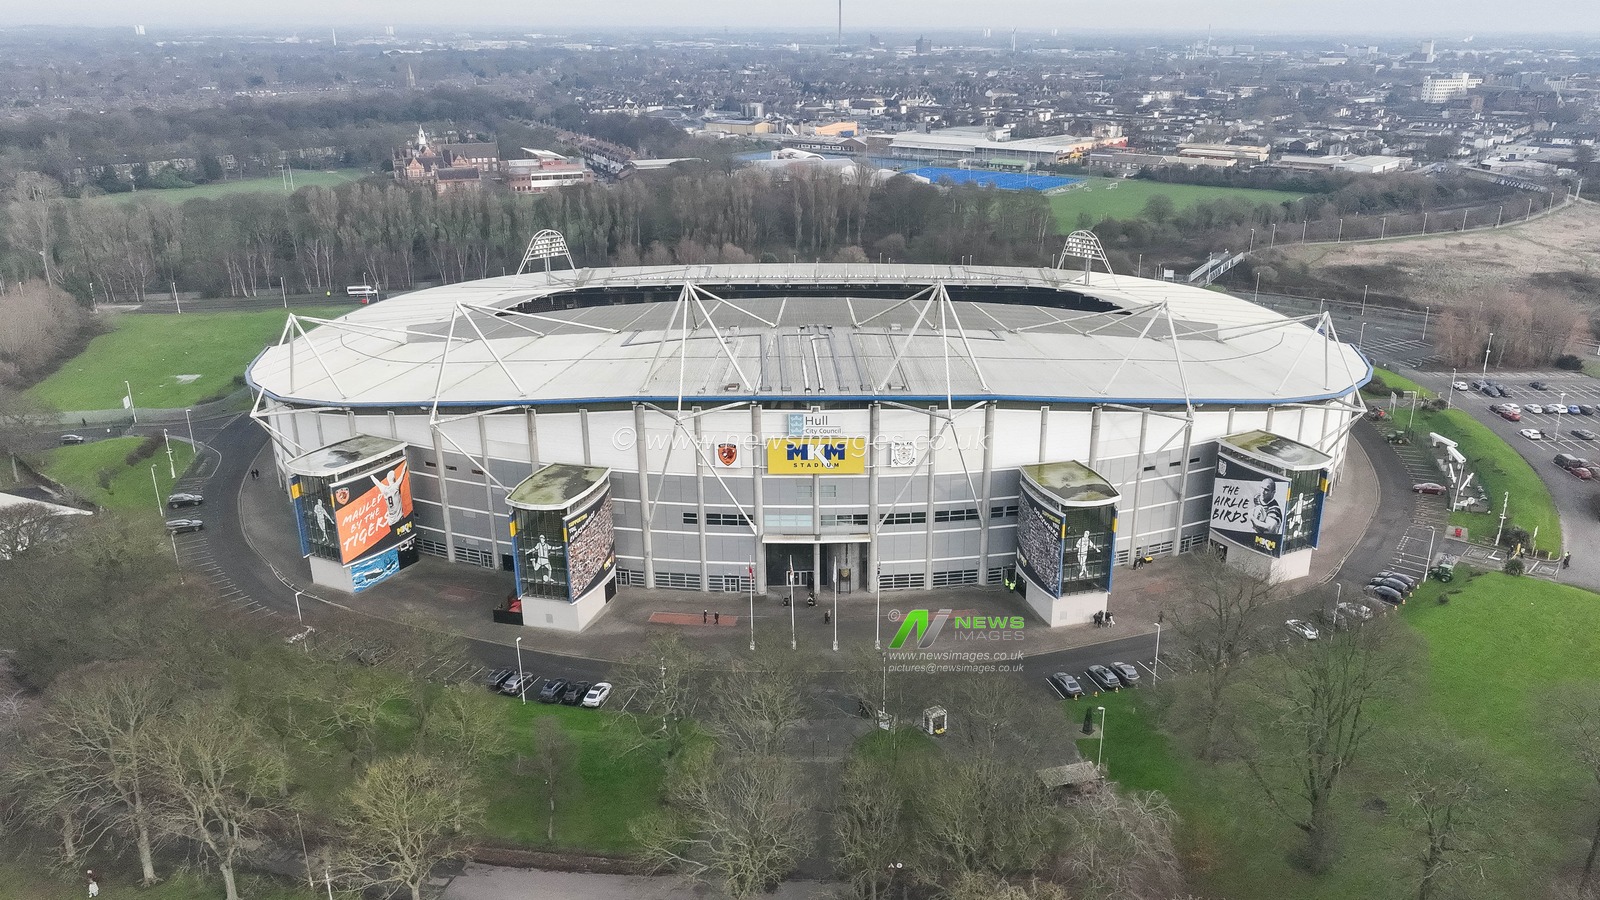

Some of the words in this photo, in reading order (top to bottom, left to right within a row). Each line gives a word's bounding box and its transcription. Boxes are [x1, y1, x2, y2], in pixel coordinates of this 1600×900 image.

[805, 415, 828, 426] Hull
[786, 444, 846, 469] MKM
[1222, 485, 1240, 496] THE
[388, 496, 394, 507] 9
[1213, 495, 1250, 509] AIRLIE
[342, 493, 384, 527] MAULED
[1212, 508, 1249, 524] BIRDS
[350, 519, 363, 534] BY
[363, 507, 380, 523] THE
[343, 511, 389, 551] TIGERS
[1255, 535, 1276, 550] MKM
